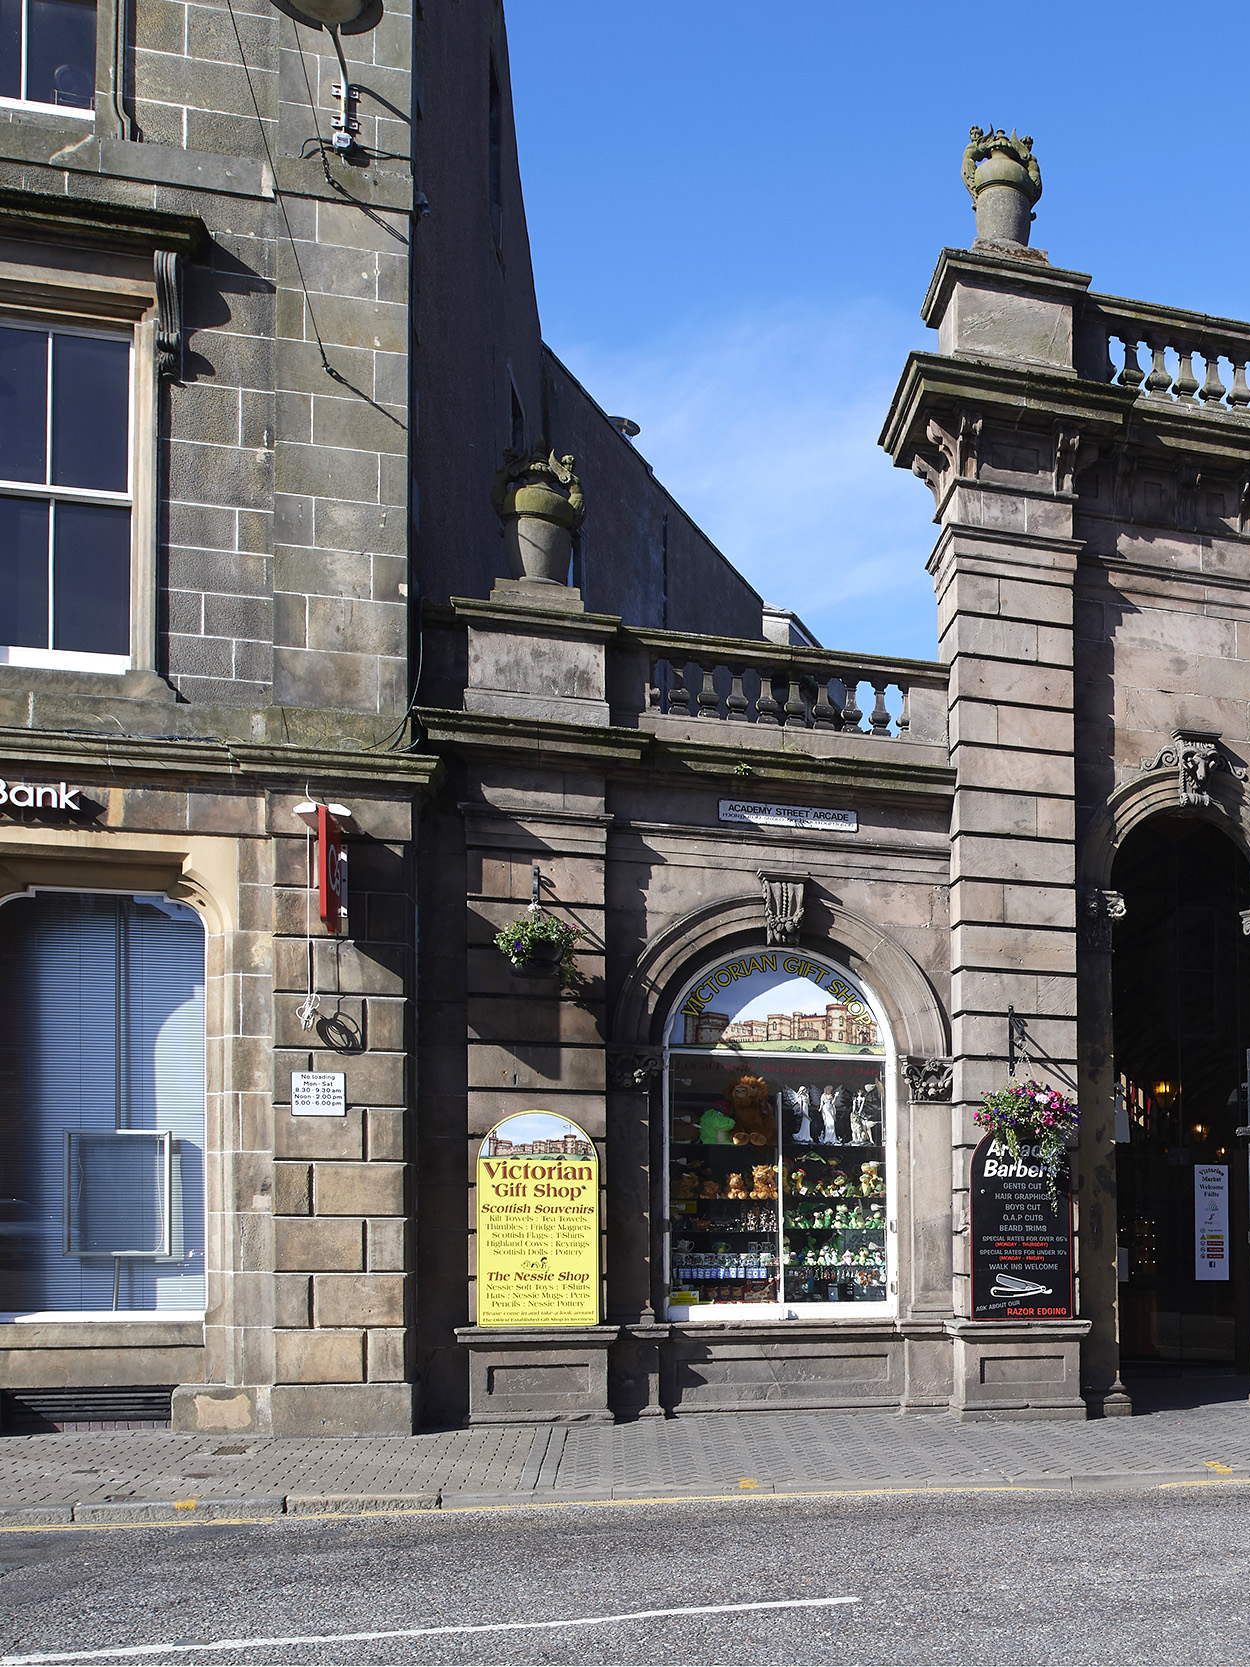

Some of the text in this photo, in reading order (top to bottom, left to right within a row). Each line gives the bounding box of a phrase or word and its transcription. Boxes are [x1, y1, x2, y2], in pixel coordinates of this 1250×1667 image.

[728, 804, 772, 815] ACADEMY
[776, 808, 810, 818] STREET
[813, 811, 849, 821] ARCADE
[681, 955, 872, 1025] VICTORIAN GIFT SHOP
[763, 1063, 820, 1076] Business
[483, 1160, 593, 1180] Victorian
[984, 1159, 1054, 1178] Barber
[1198, 1168, 1225, 1177] Victorian
[1003, 1182, 1043, 1190] GENTS CUT
[495, 1182, 582, 1201] Gift Shop
[1014, 1193, 1051, 1201] GRAPHICS
[481, 1204, 595, 1214] Scottish Souvenirs
[1003, 1214, 1044, 1222] O.A.P CUTS
[558, 1224, 591, 1232] Magnets
[526, 1232, 548, 1240] Flags
[486, 1240, 523, 1248] Highland
[556, 1241, 590, 1249] Keyrings
[494, 1248, 526, 1256] Scottish
[556, 1249, 583, 1257] Pottery
[487, 1271, 590, 1283] The Nessie Shop
[535, 1284, 554, 1292] Toys
[542, 1292, 564, 1300] Mugs
[988, 1302, 1007, 1310] ABOUT
[1007, 1308, 1035, 1316] RAZOR
